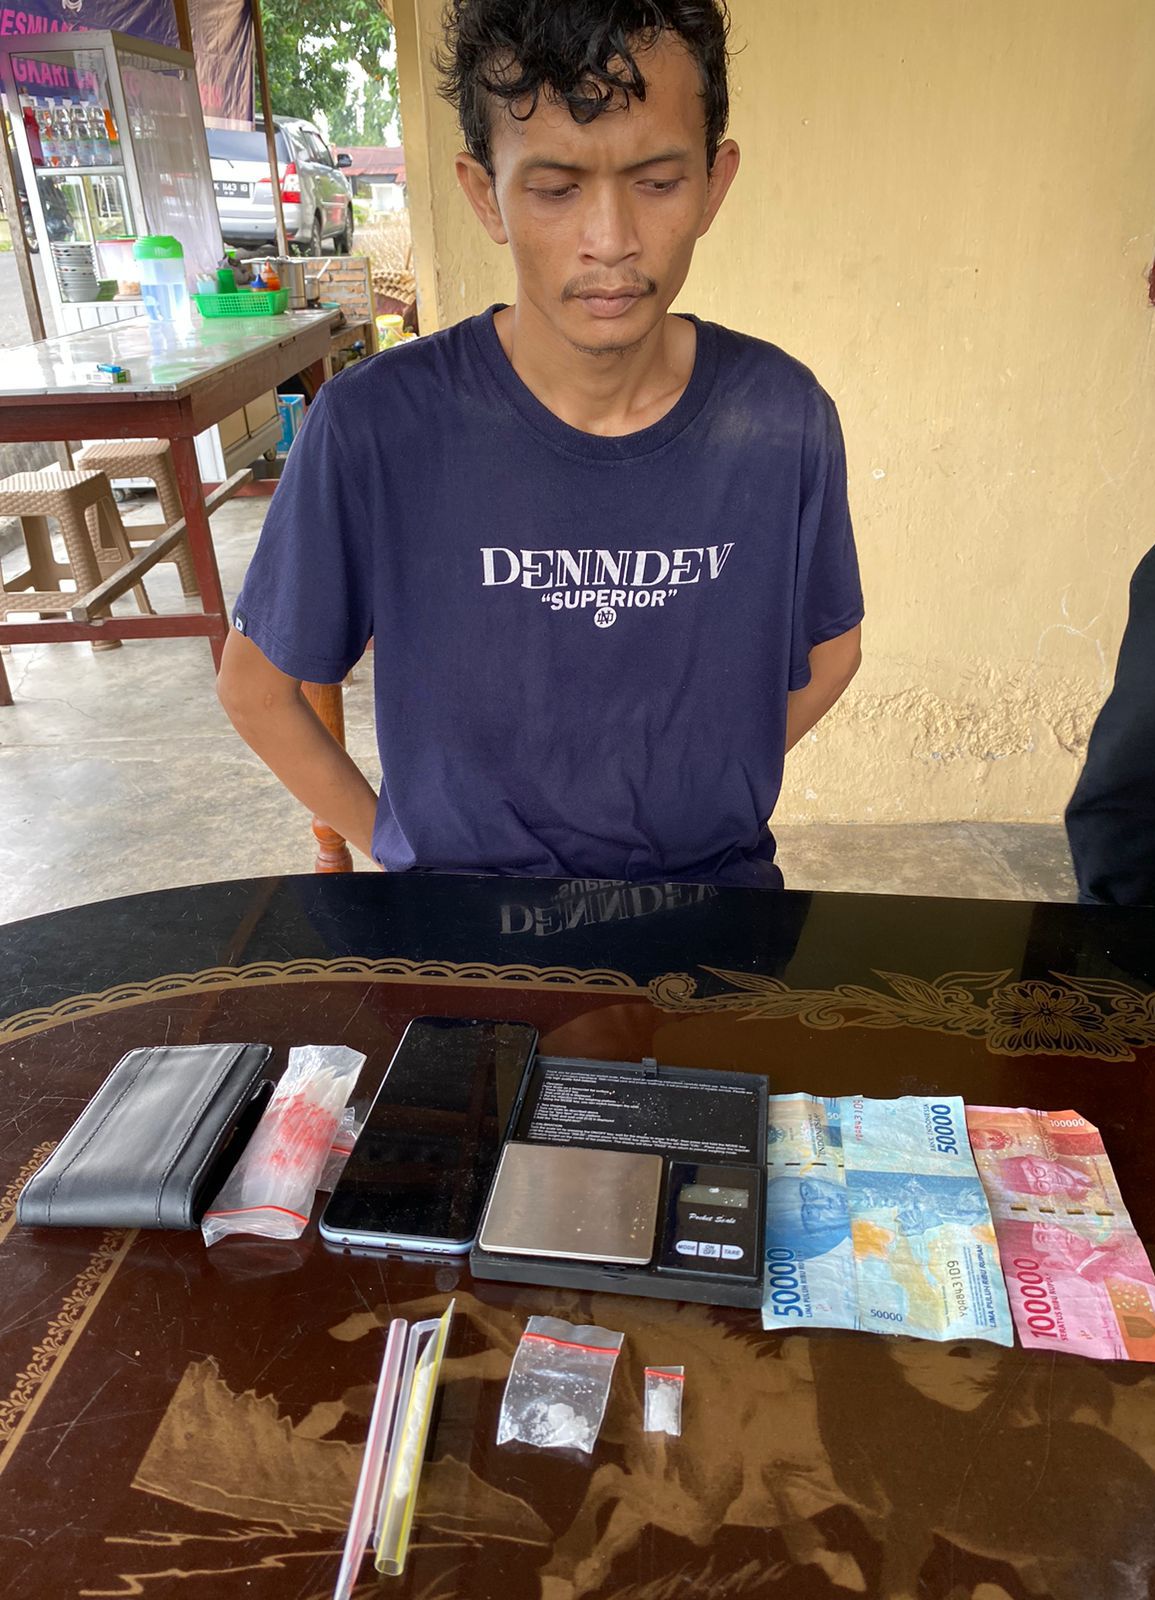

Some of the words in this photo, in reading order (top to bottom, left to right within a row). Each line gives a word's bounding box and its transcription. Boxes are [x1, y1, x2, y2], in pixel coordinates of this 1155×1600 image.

[480, 543, 735, 589] DENNDEV
[931, 1104, 958, 1155] 50000
[1050, 1119, 1085, 1128] 100000
[766, 1248, 803, 1317] 50000
[1013, 1258, 1058, 1338] 100000
[870, 1308, 903, 1322] 50000
[987, 1310, 997, 1328] LIMA
